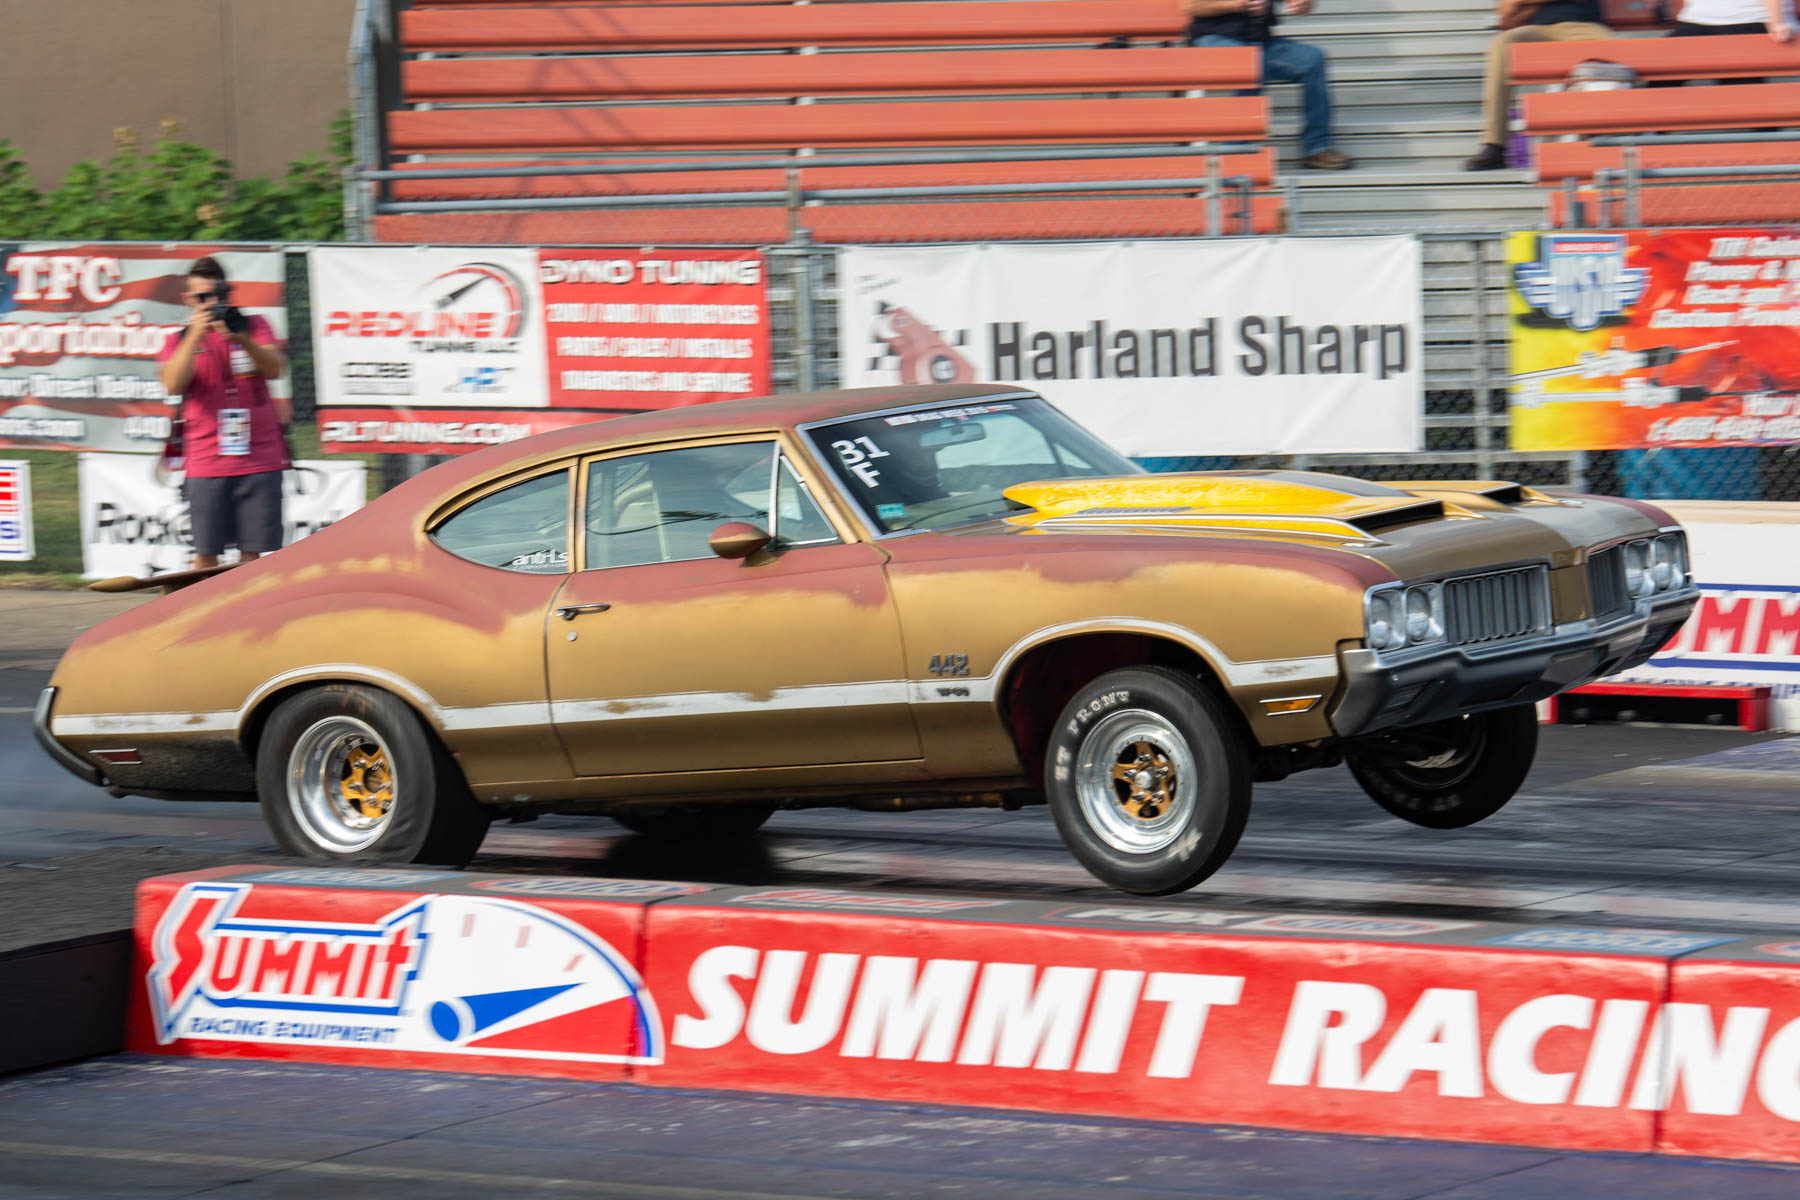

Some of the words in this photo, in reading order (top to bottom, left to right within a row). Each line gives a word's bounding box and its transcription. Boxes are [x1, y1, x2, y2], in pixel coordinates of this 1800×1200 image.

[5, 255, 122, 303] TFC
[637, 259, 761, 285] TUNING
[0, 311, 183, 365] portatio
[321, 311, 496, 337] REDLINE
[991, 316, 1220, 382] Harland
[1236, 315, 1408, 380] Sharp
[831, 435, 890, 465] 31
[849, 461, 880, 488] F
[928, 653, 970, 676] 442
[1068, 908, 1256, 926] FOX
[671, 944, 1246, 1079] SUMMIT
[190, 1015, 267, 1037] RACING
[272, 1020, 402, 1044] EQUIPMENT
